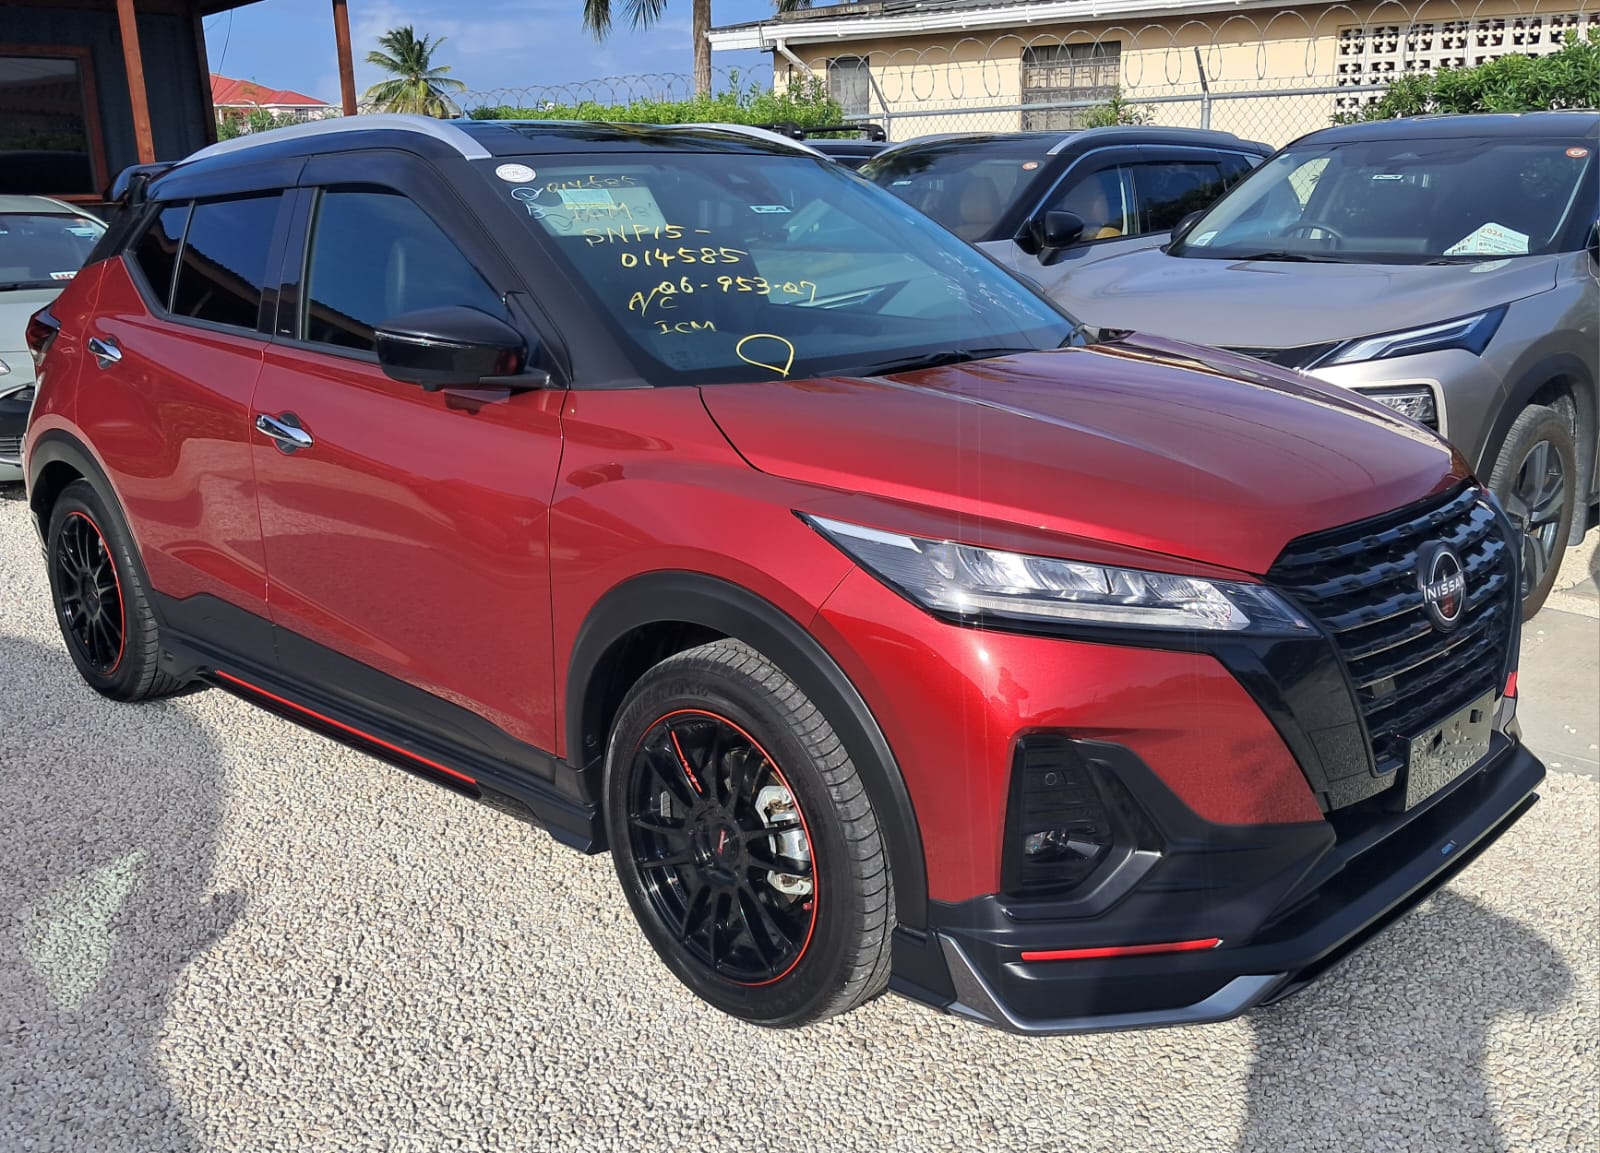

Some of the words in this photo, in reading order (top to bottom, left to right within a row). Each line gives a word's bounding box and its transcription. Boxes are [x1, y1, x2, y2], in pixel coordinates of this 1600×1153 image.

[621, 247, 748, 268] 014585
[654, 320, 717, 335] ICM
[1427, 574, 1464, 599] NISSAN
